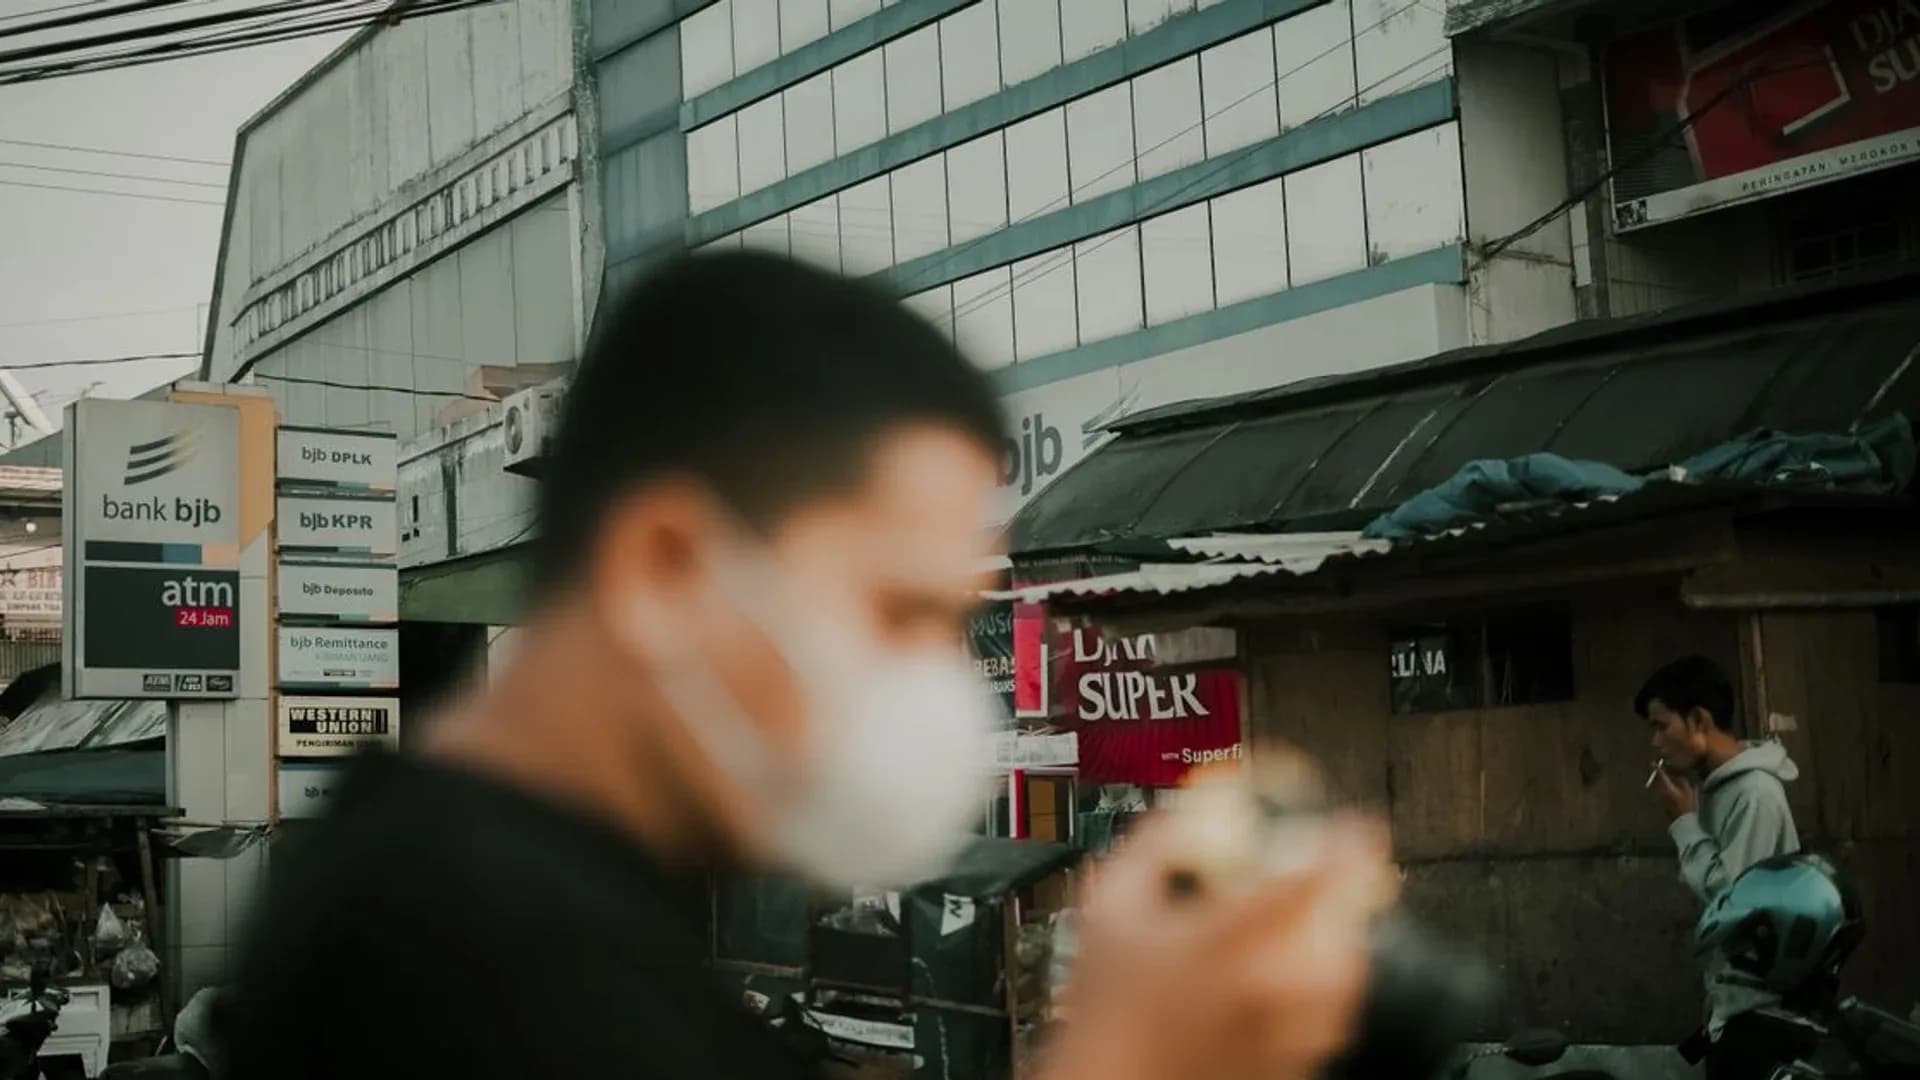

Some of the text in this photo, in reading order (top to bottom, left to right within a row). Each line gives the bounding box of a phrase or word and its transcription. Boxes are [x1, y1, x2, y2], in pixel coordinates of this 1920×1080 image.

[302, 446, 372, 465] bjb DPLK
[103, 494, 221, 528] bank bjb
[300, 512, 373, 531] bjb KPR
[161, 576, 233, 607] atm
[303, 582, 374, 596] bjb Deposito
[180, 611, 229, 626] 24 Jam
[290, 636, 388, 650] bjb Remittance
[1078, 671, 1211, 721] SUPER
[290, 709, 372, 721] WESTERN
[316, 721, 372, 733] UNION
